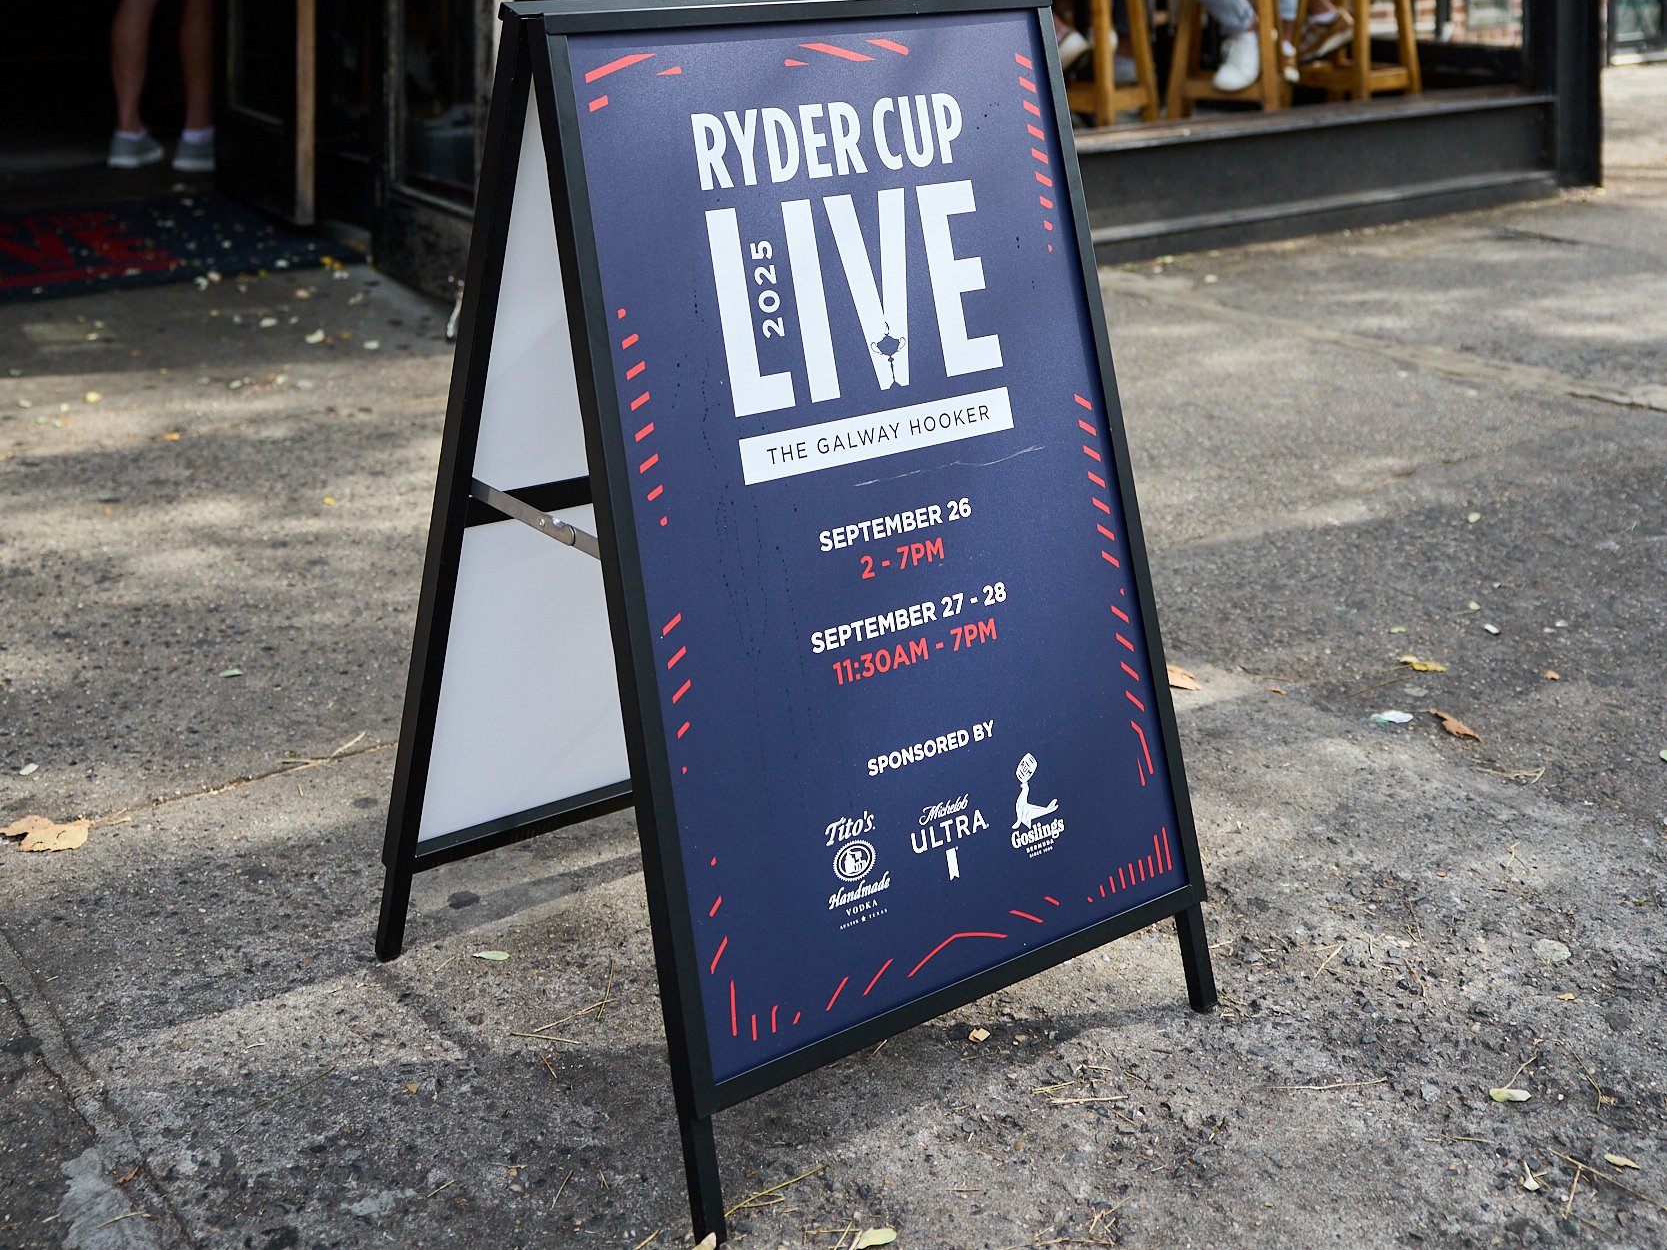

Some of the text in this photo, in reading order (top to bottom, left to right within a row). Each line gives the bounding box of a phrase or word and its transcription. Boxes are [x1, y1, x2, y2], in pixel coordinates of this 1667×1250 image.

[690, 93, 963, 191] RYDER CUP
[705, 179, 1004, 418] LIVE
[749, 239, 786, 340] 2025
[767, 404, 991, 466] THE GALWAY HOOKER
[819, 497, 972, 552] SEPTEMBER 26
[860, 555, 875, 579] 2
[896, 537, 945, 570] 7PM
[811, 601, 936, 654] SEPTEMBER
[941, 592, 964, 618] 27
[982, 581, 1007, 607] 28
[832, 637, 929, 686] 11:30AM
[950, 617, 997, 652] 7PM
[867, 719, 995, 777] SPONSORED BY
[824, 810, 876, 847] Tito's
[910, 809, 989, 854] ULTRA
[919, 793, 969, 826] Michelob
[1011, 818, 1065, 849] Goslings
[828, 870, 891, 910] Handmade
[845, 899, 878, 917] VODKA
